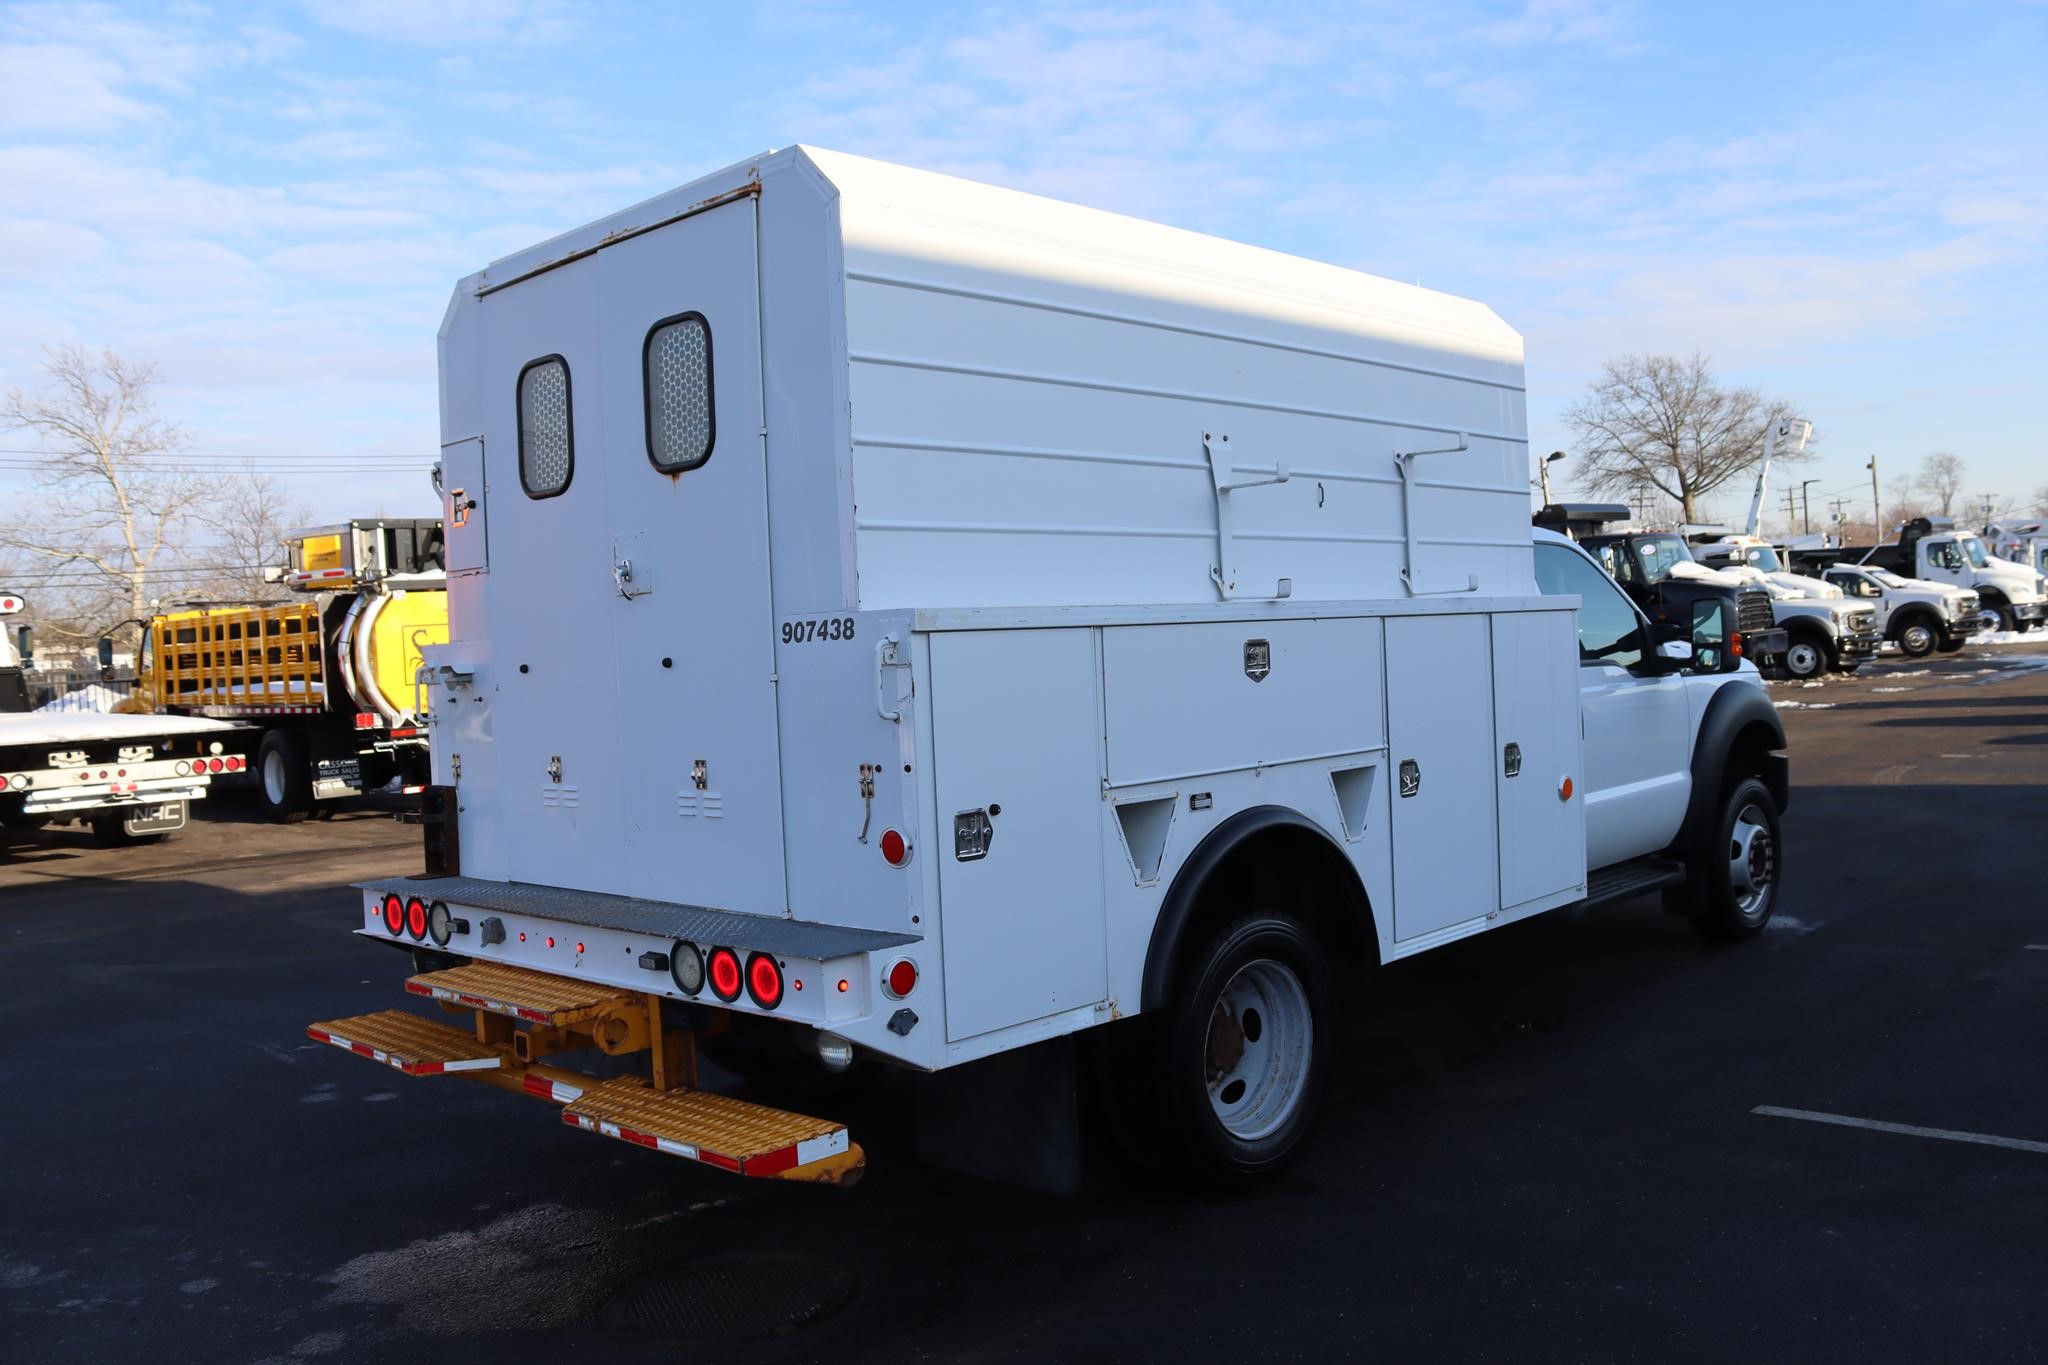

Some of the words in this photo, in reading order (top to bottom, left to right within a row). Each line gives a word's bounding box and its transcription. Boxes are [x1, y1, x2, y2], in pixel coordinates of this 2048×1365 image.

[782, 617, 855, 644] 907438
[318, 759, 360, 769] CASSONE
[319, 768, 340, 777] TRUCK
[340, 766, 360, 774] SALES
